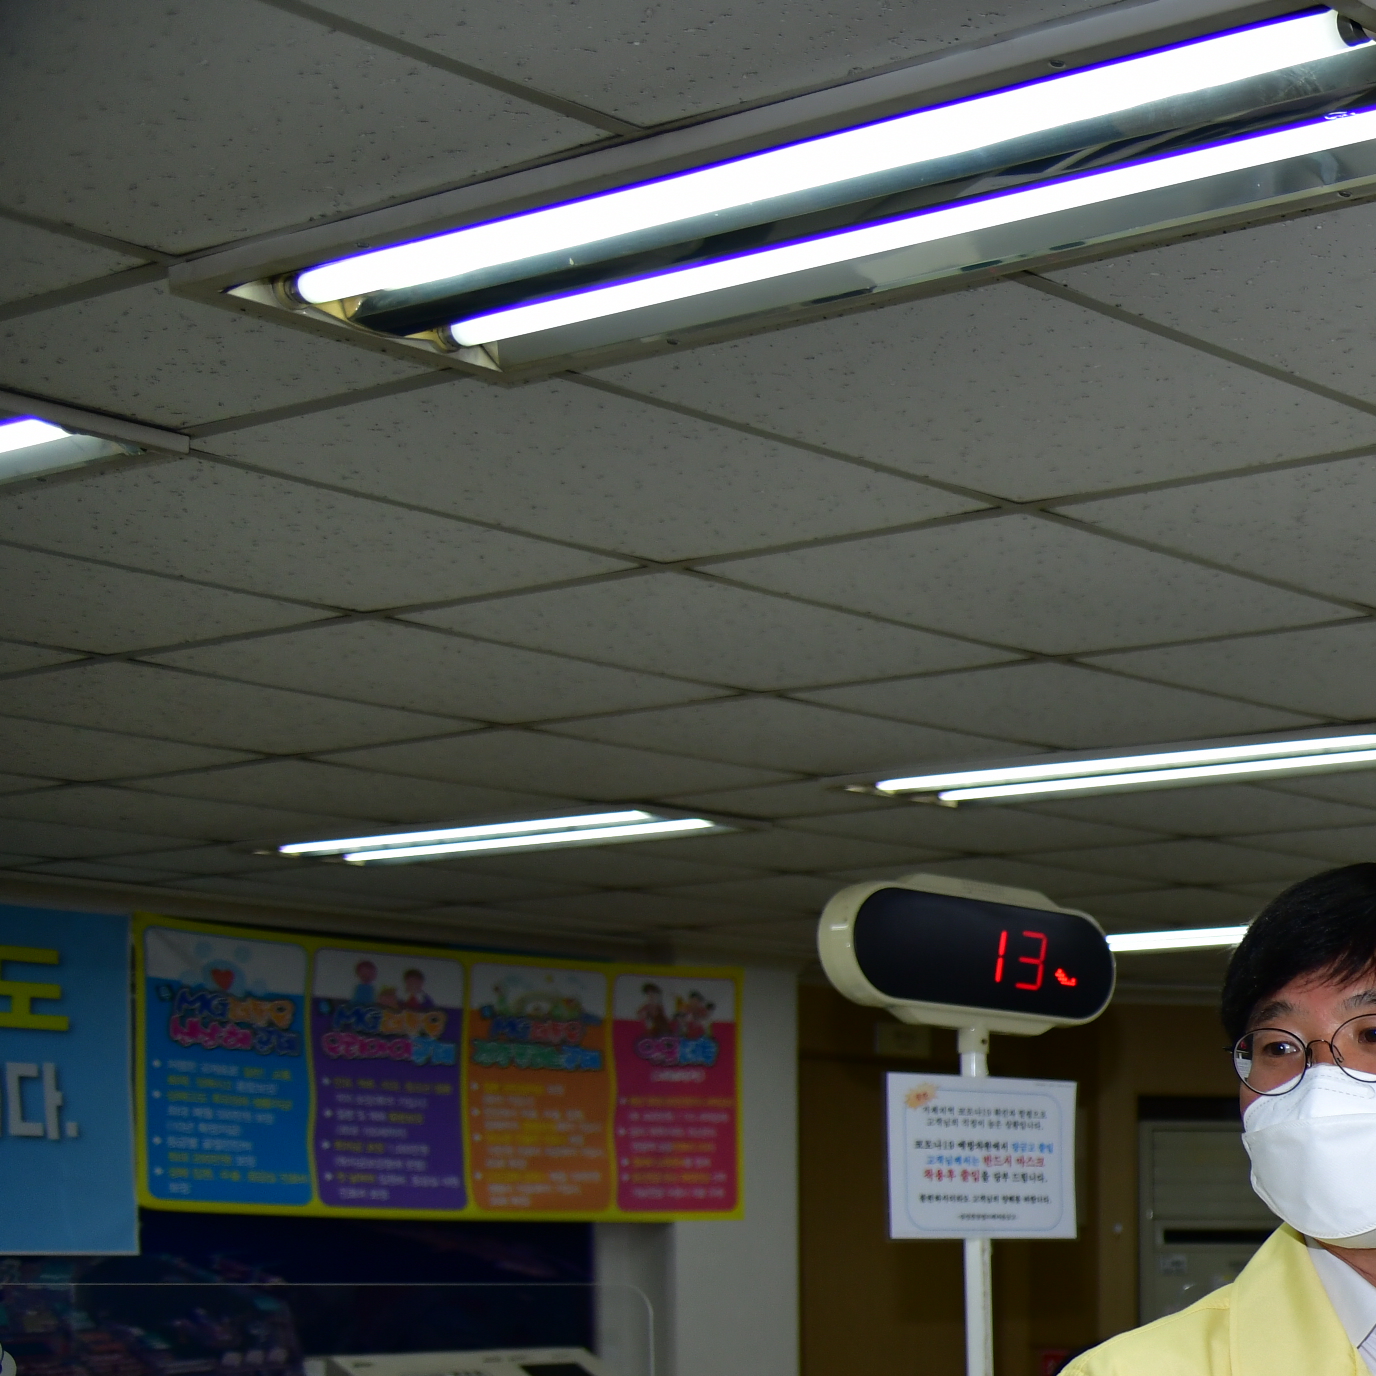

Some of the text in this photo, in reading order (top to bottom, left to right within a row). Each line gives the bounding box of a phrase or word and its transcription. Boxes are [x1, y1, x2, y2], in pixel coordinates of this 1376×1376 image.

[994, 929, 1048, 991] 13
[0, 1058, 79, 1142] 다.
[958, 1107, 991, 1117] 코로나19
[994, 1108, 1016, 1118] 확진자
[1018, 1109, 1048, 1119] 발생으로
[926, 1117, 959, 1128] 고객님의
[914, 1140, 955, 1151] 코로나19
[957, 1140, 1009, 1152] 예방차원에서
[982, 1154, 1013, 1167] 반드시
[1015, 1156, 1046, 1168] 마스크
[923, 1168, 956, 1182] 착용후
[960, 1168, 991, 1183] 출입을
[1012, 1172, 1049, 1184] 드립니다.
